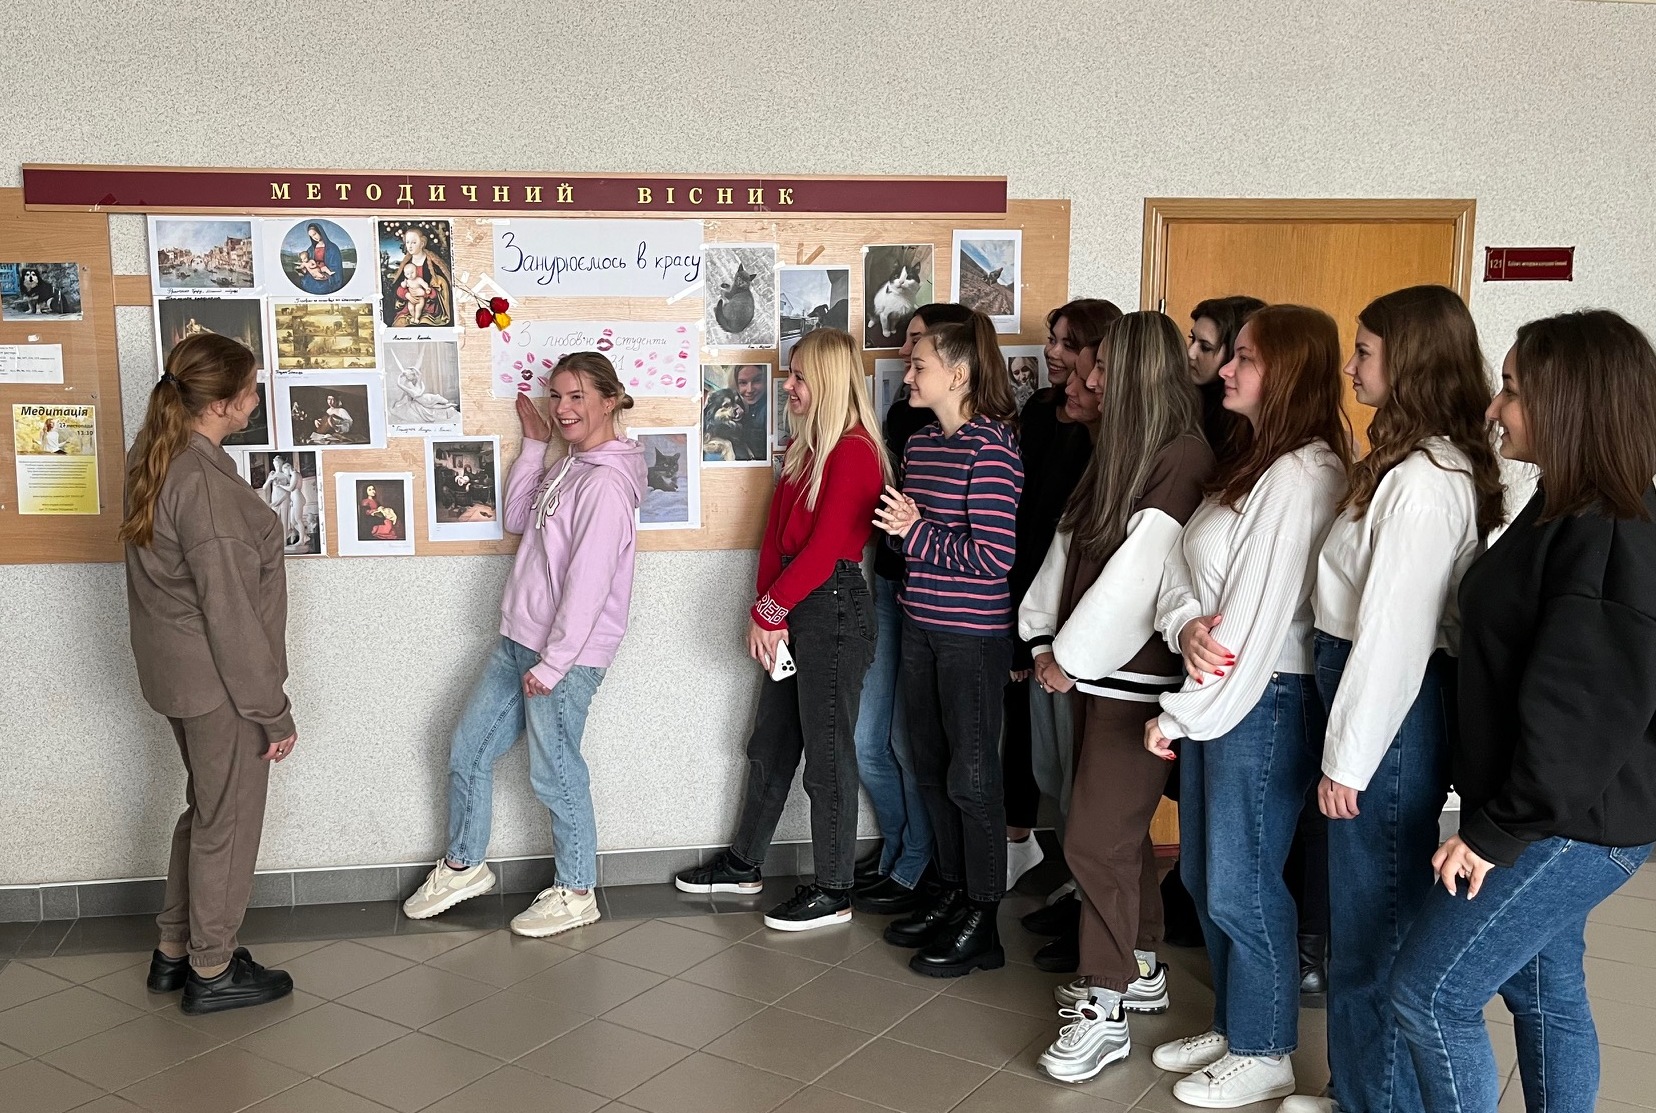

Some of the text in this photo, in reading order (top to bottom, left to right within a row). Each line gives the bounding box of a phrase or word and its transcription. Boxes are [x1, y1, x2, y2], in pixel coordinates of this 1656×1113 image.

[270, 183, 794, 205] МЕТОДИЧНИЙ ВІСНИК
[501, 232, 701, 285] Занурюємось в красу
[1490, 259, 1503, 269] 121
[615, 335, 667, 351] студенти
[21, 406, 88, 418] Медитація
